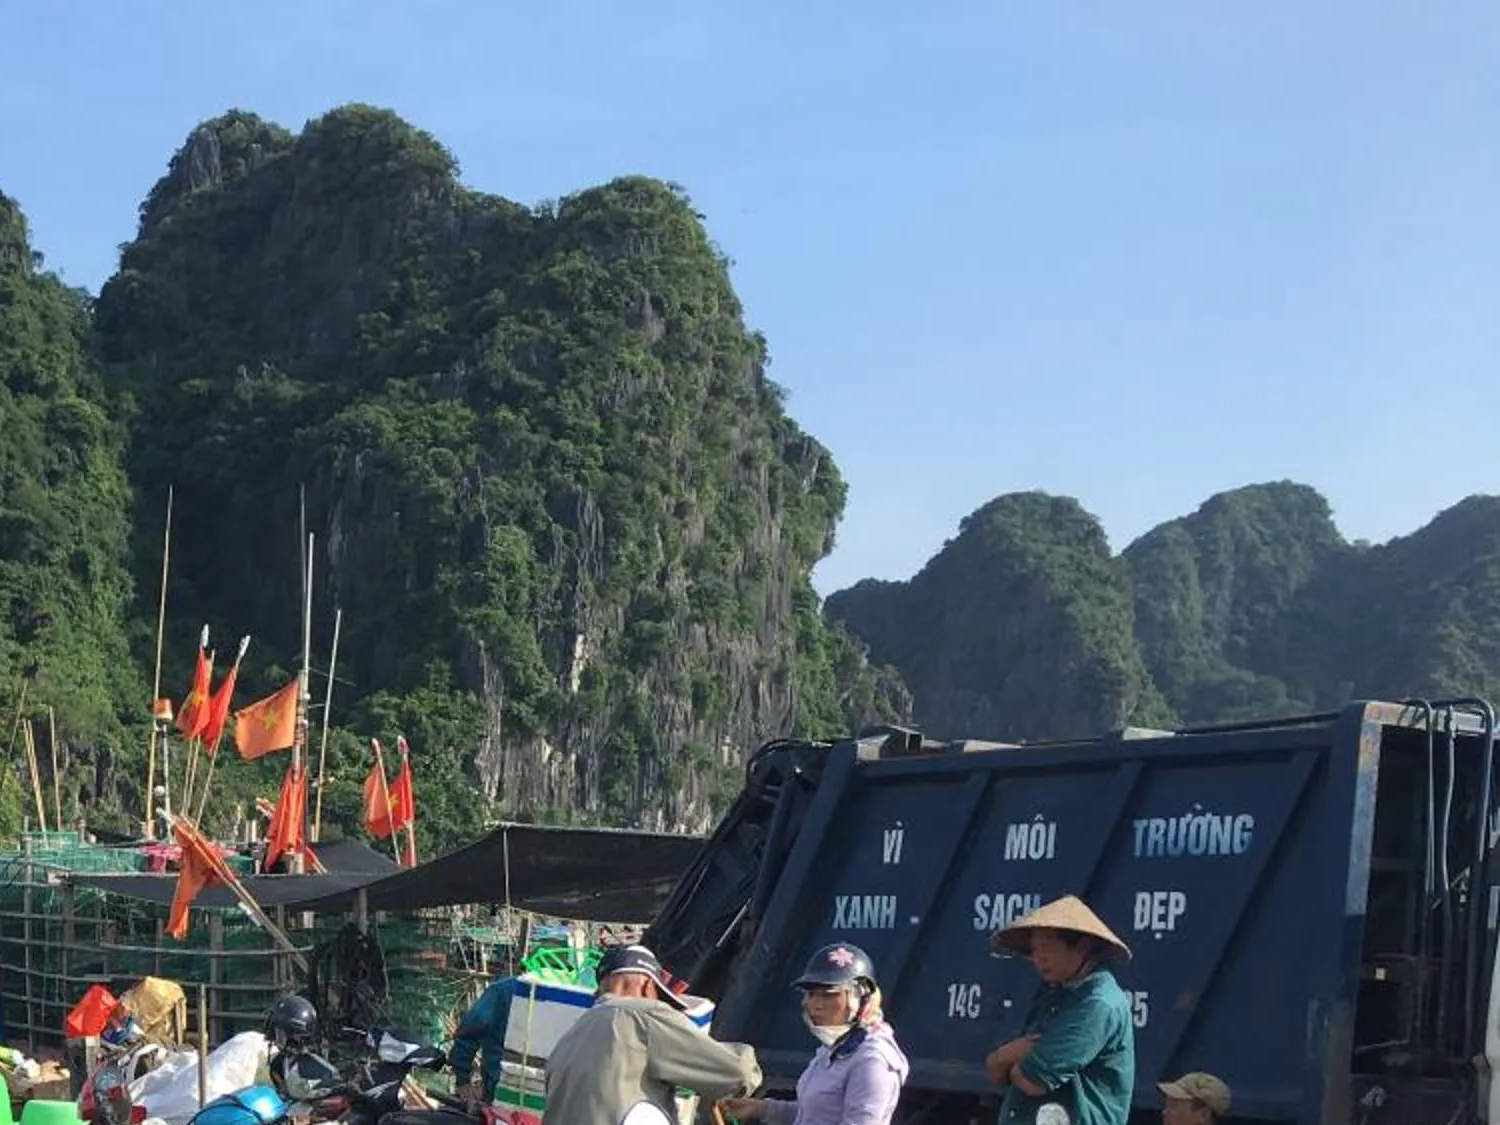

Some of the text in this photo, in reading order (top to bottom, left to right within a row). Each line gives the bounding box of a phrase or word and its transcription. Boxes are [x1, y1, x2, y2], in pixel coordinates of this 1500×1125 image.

[883, 803, 1255, 864] VÌ MÔI TRƯỜNG
[832, 895, 897, 929] XANH
[1134, 891, 1186, 940] ĐẸP
